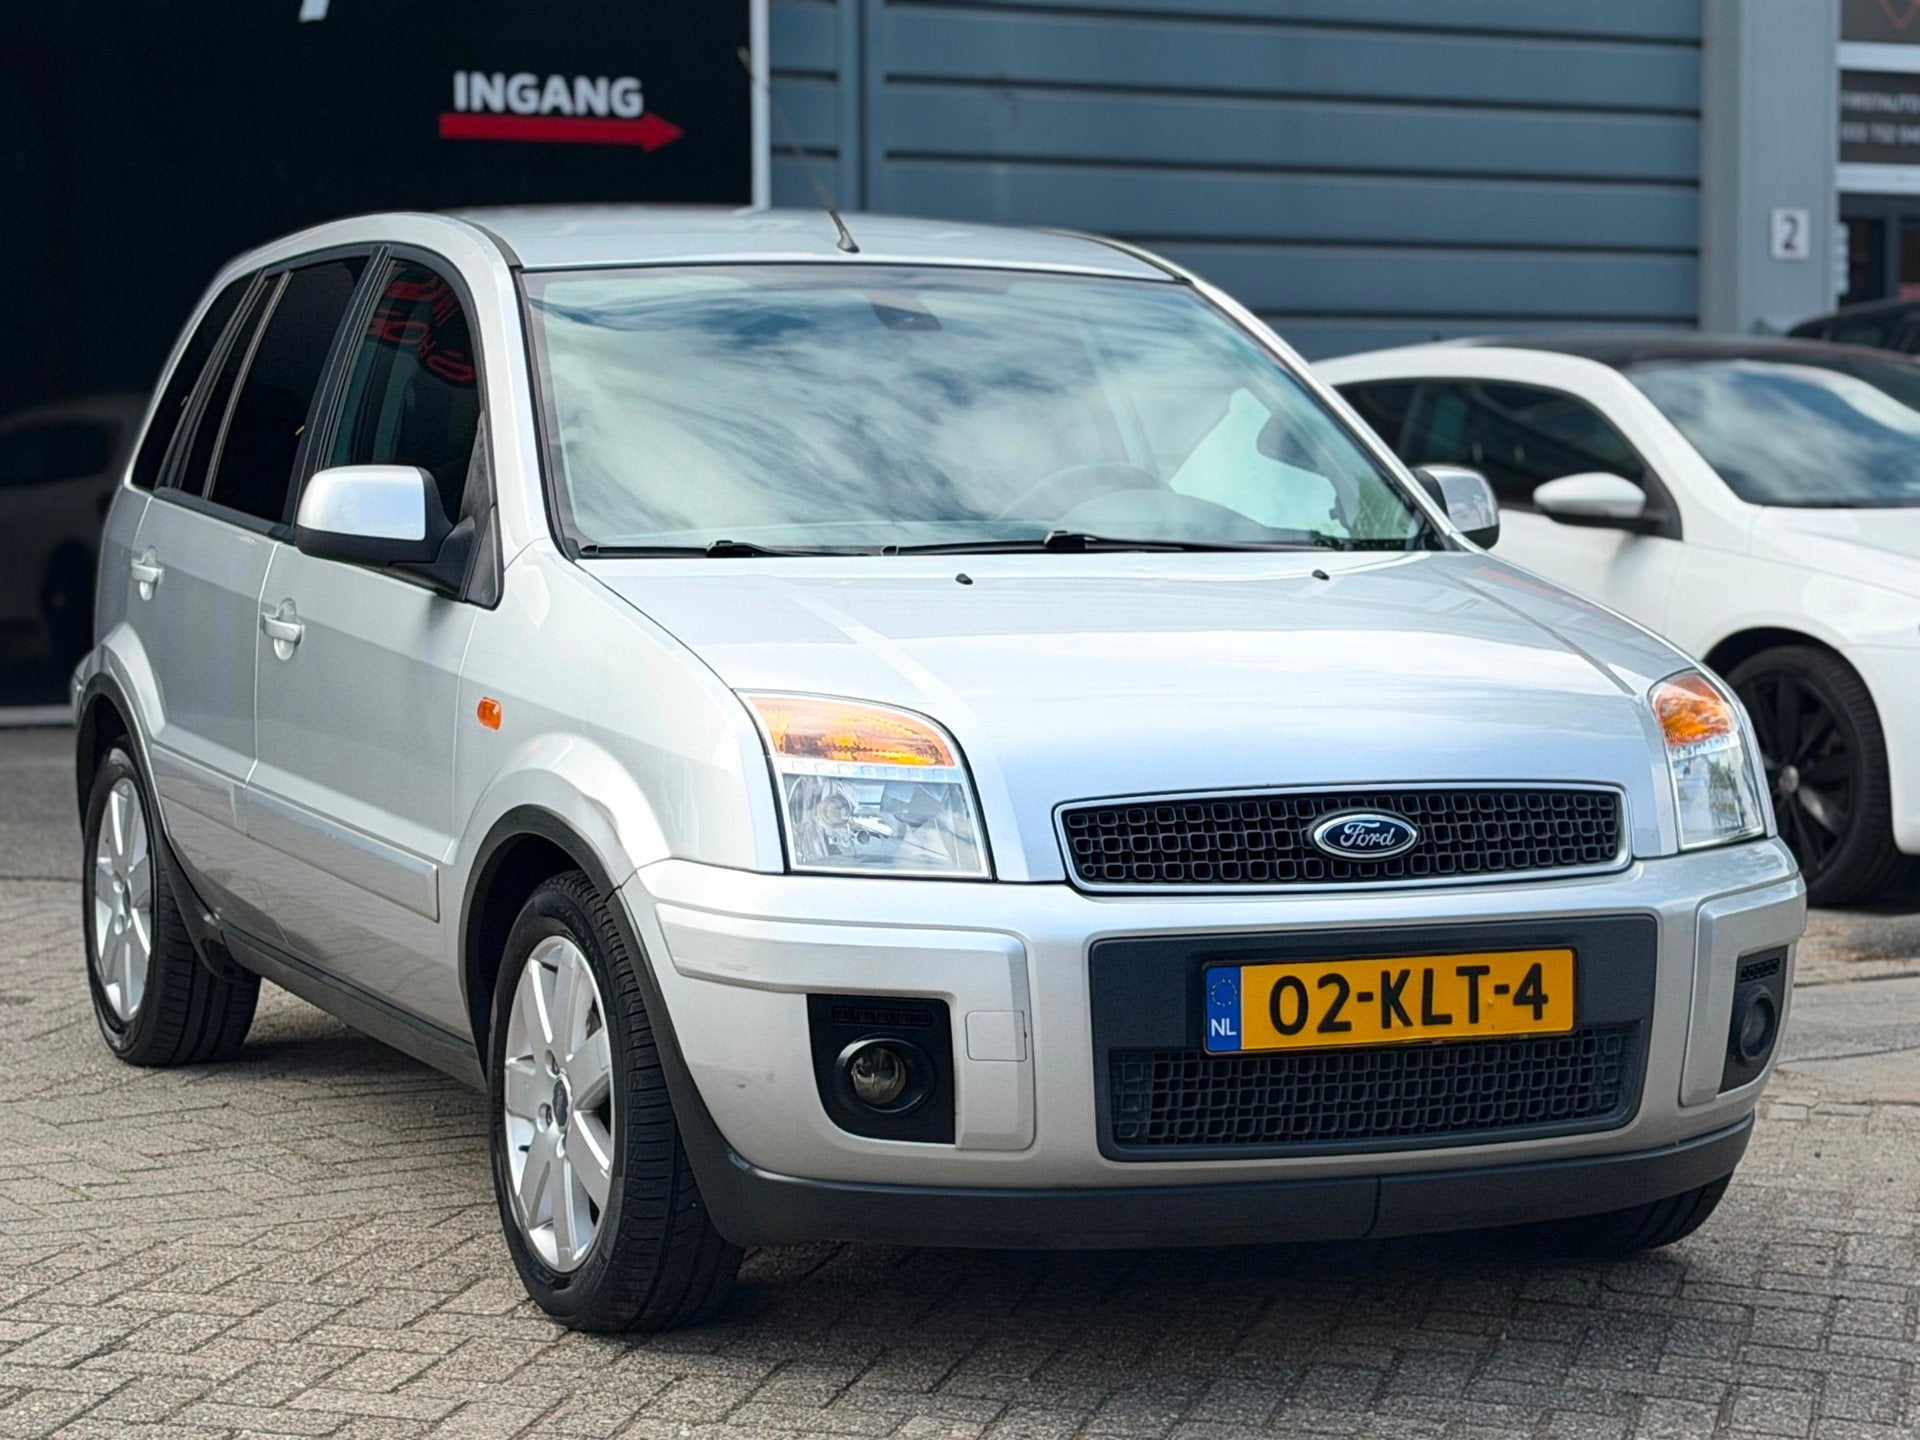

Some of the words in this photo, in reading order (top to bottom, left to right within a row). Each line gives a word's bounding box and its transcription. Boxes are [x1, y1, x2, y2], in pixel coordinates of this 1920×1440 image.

[453, 70, 644, 119] INGANG
[1781, 214, 1798, 251] 2
[1340, 821, 1396, 848] Ford
[1210, 1016, 1237, 1038] NL
[1268, 962, 1549, 1037] 02-KLT-4
